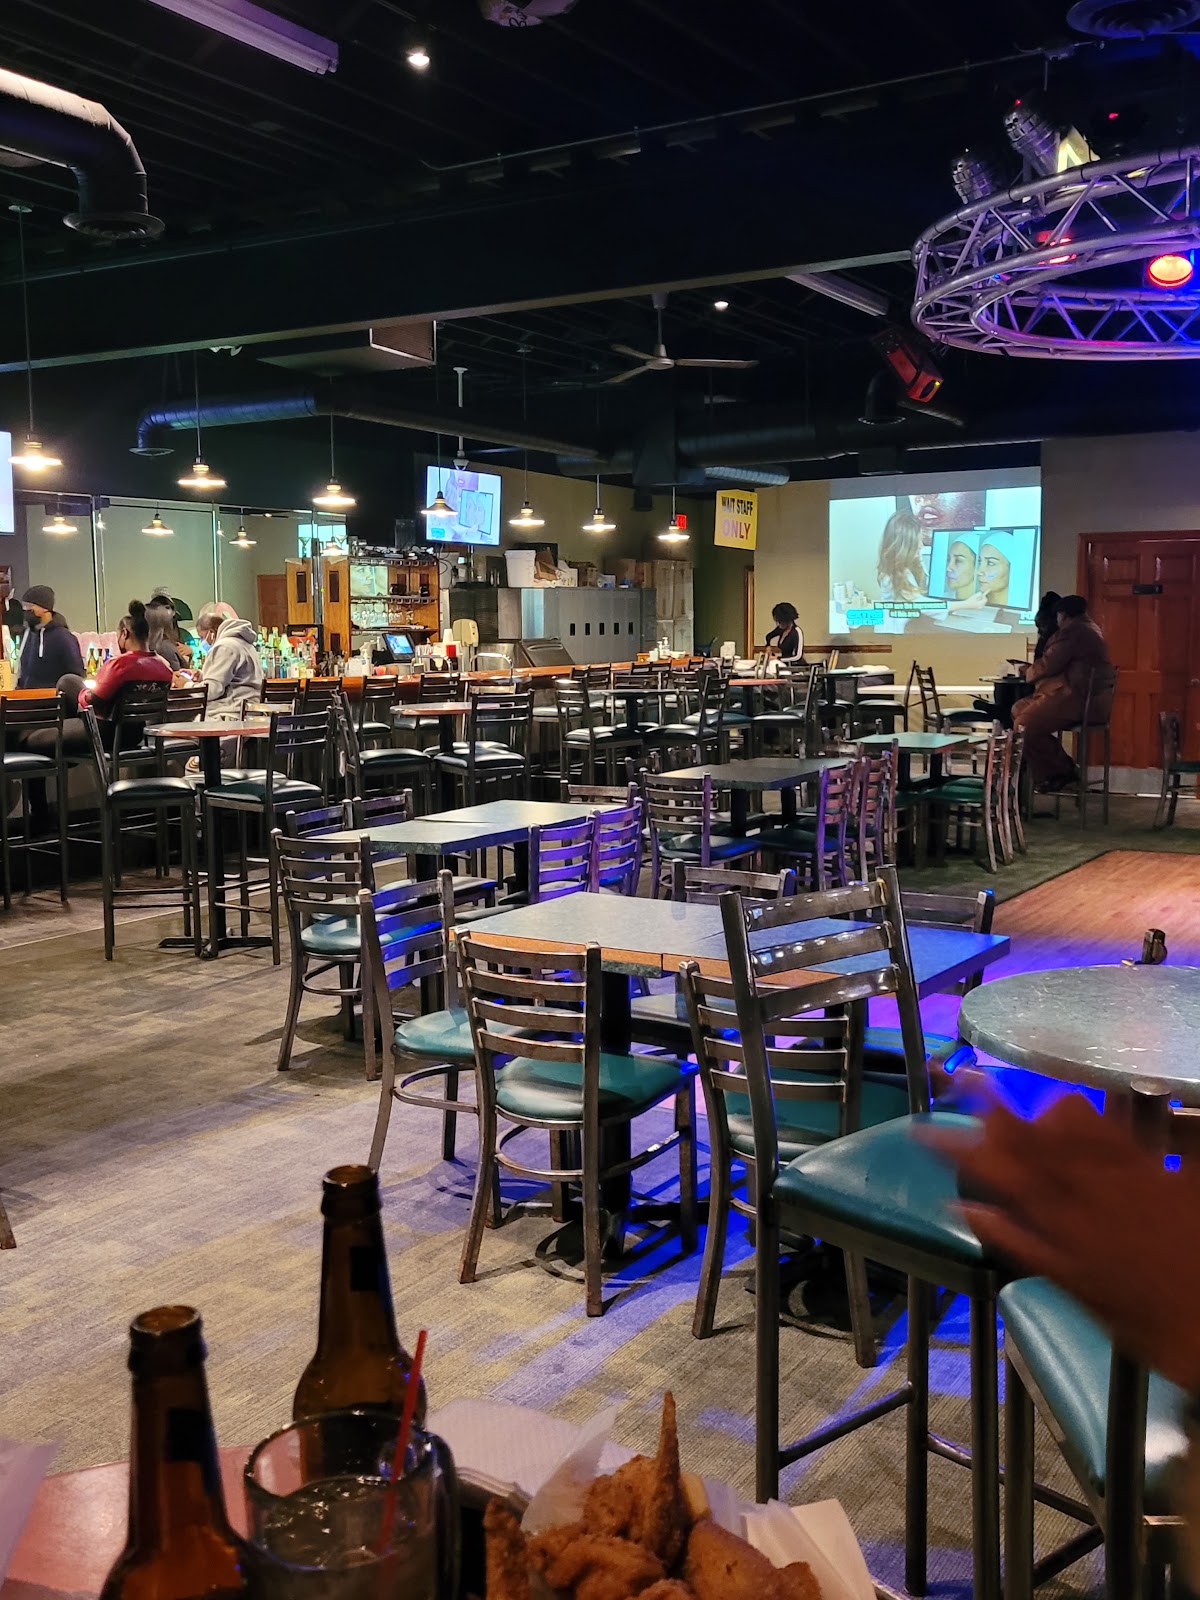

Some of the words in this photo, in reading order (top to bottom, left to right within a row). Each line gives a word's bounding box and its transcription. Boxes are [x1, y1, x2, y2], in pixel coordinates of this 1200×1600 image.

[721, 496, 735, 513] WAIT
[737, 498, 753, 516] STAFF
[722, 518, 751, 540] ONLY
